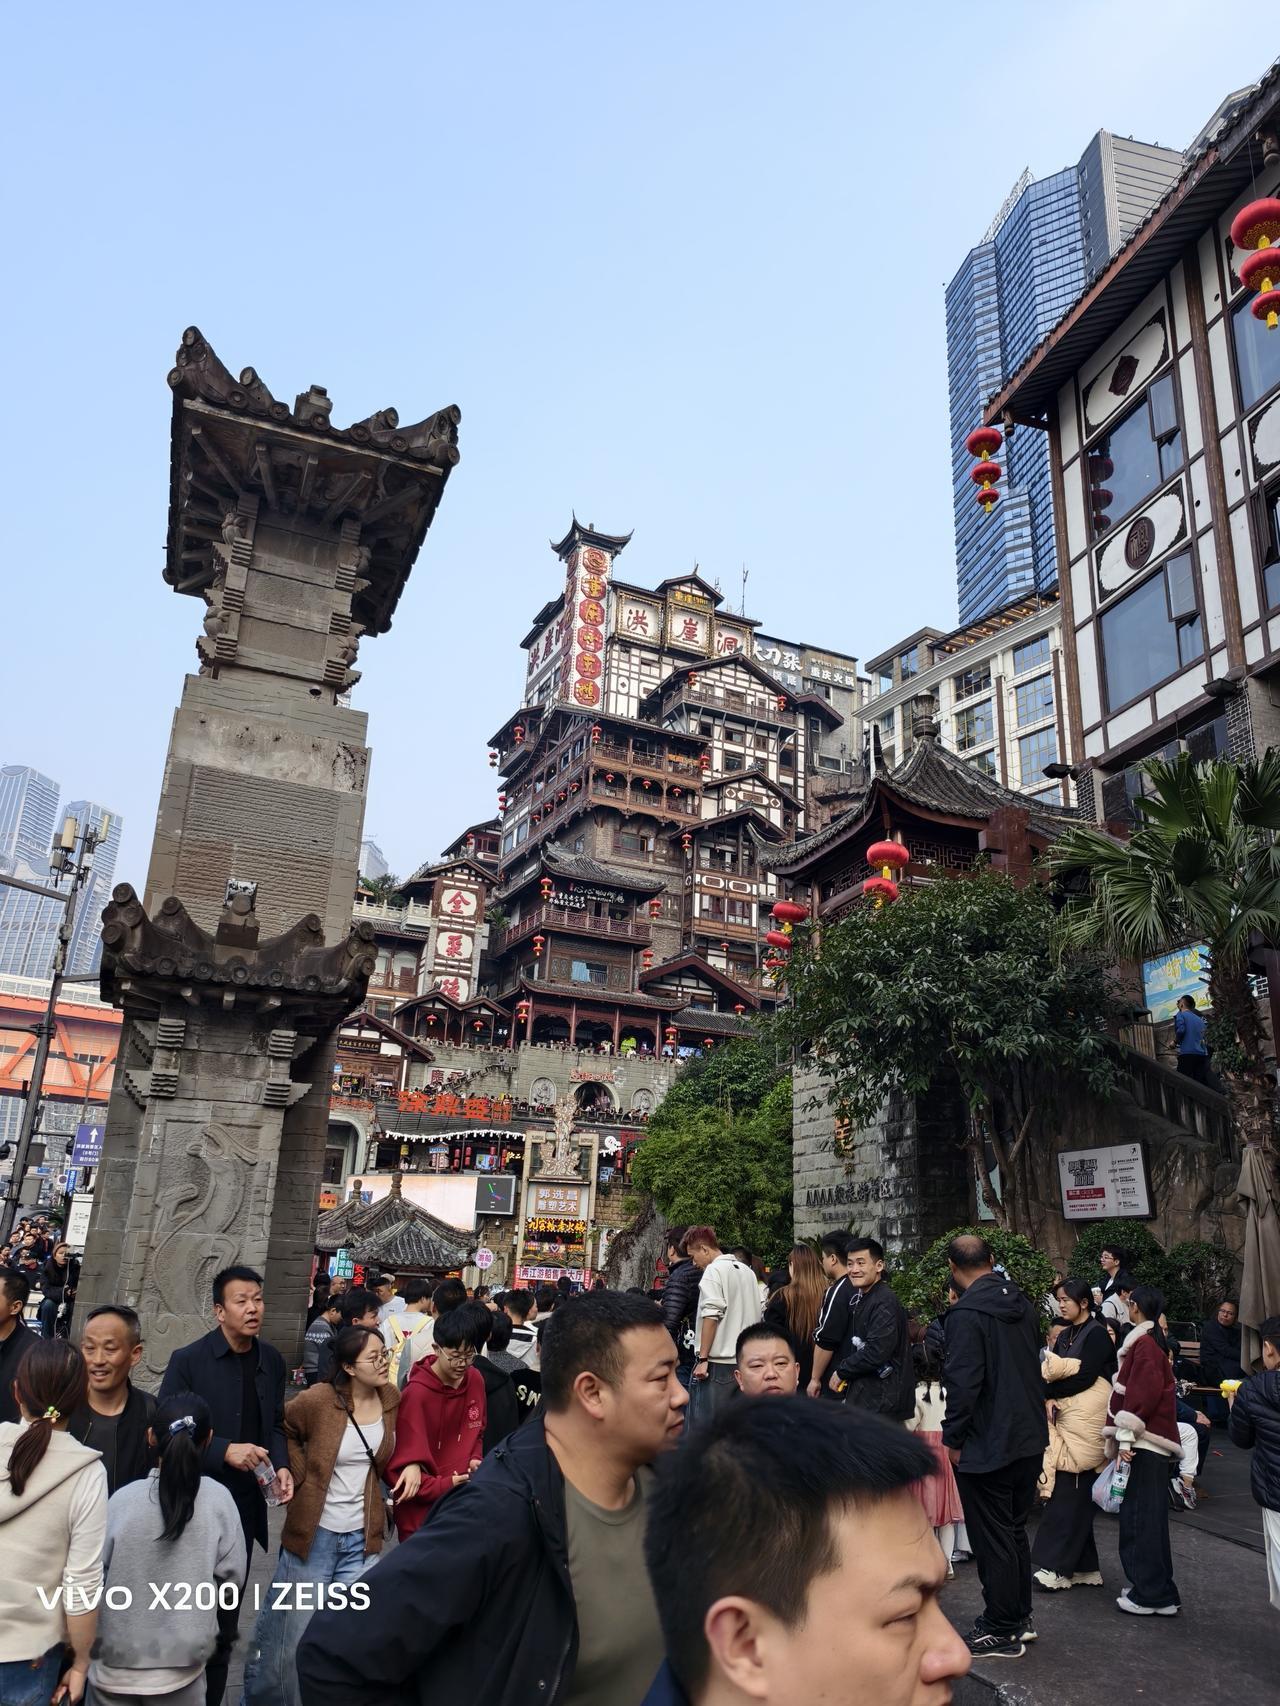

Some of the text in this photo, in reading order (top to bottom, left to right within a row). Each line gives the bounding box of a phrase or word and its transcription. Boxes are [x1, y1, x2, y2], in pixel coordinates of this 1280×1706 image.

[627, 607, 739, 655] 洪崖洞
[528, 1218, 586, 1232] 九宫格老火锅
[353, 1264, 365, 1285] 安全
